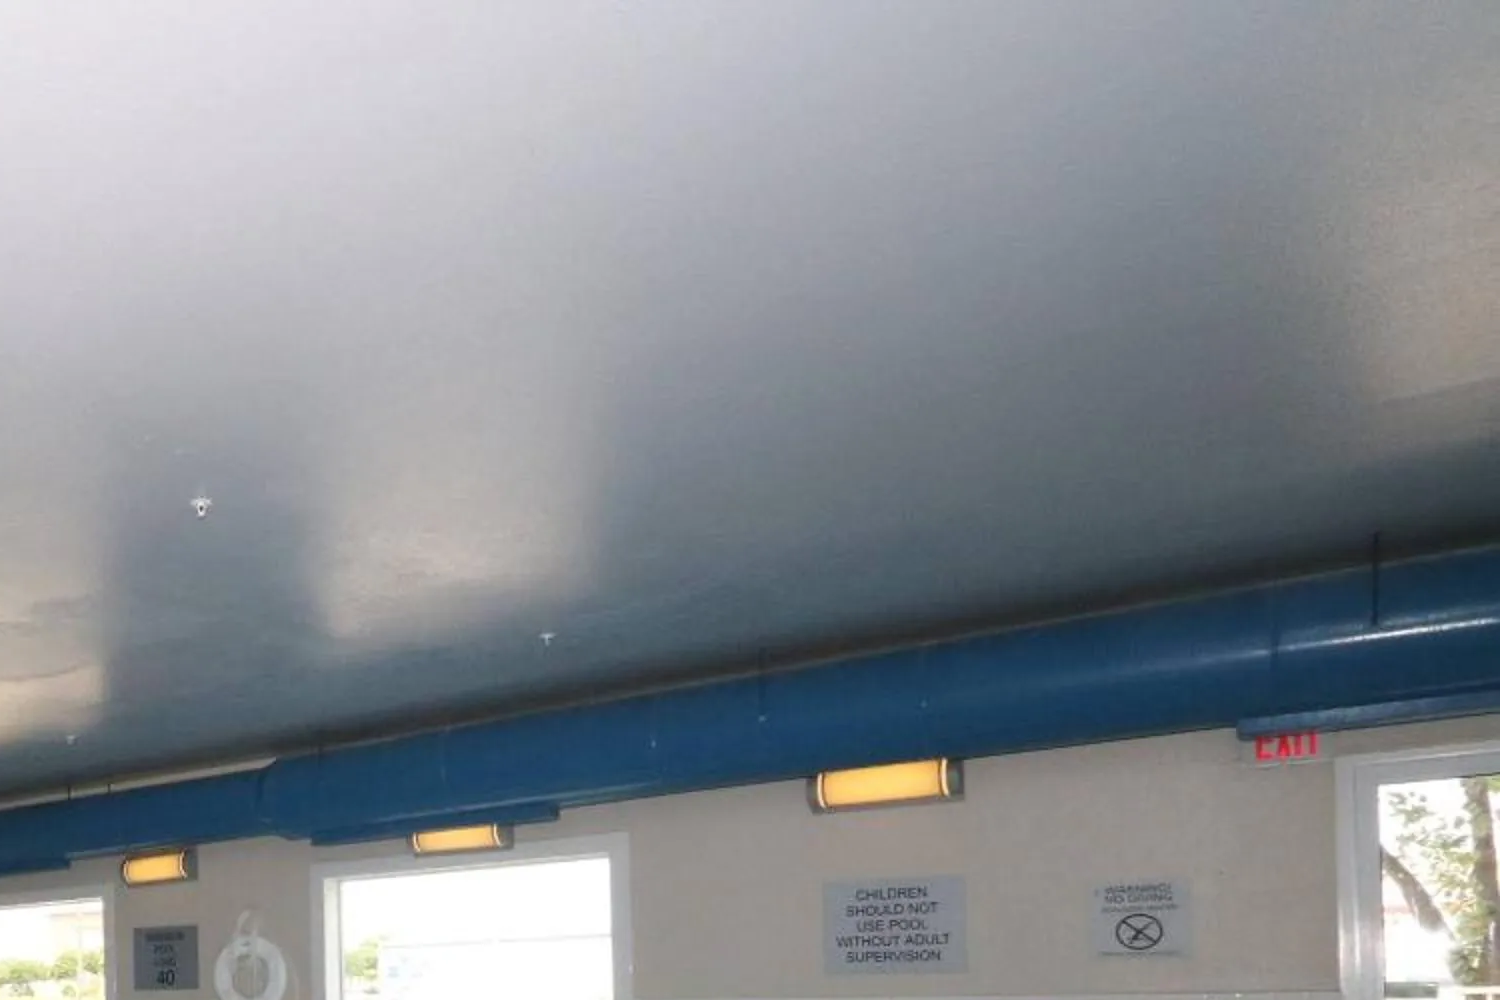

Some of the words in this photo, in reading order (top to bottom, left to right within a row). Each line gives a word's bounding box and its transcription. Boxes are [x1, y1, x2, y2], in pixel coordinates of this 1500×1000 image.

[855, 886, 928, 902] CHILDREN
[846, 903, 904, 917] SHOULD
[908, 901, 939, 914] NOT
[856, 919, 885, 933] USE
[889, 918, 929, 931] POOL
[836, 935, 901, 948] WITHOUT
[905, 933, 950, 946] ADULT
[846, 950, 942, 963] SUPERVISION
[156, 969, 176, 986] 40
